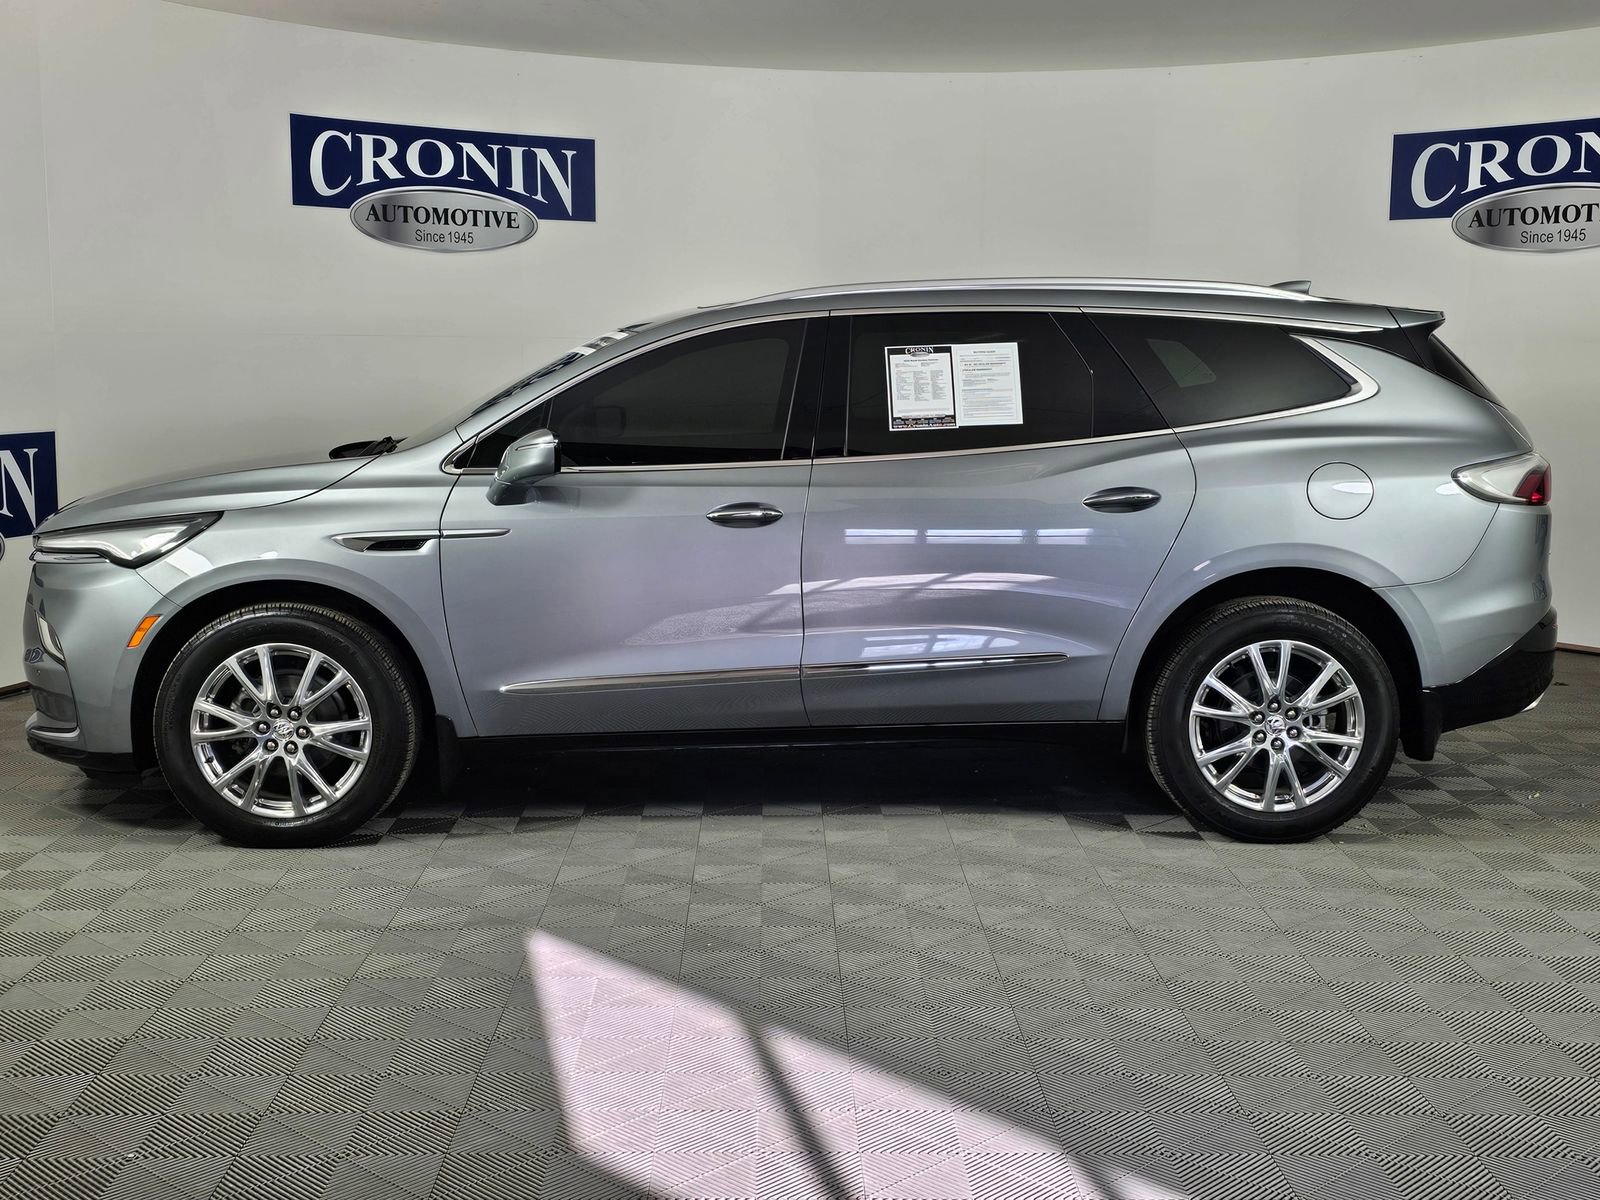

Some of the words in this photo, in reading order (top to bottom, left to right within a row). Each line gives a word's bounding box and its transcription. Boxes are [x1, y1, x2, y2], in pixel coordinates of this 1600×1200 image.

[309, 130, 577, 217] CRONIN
[365, 204, 520, 229] AUTOMOTIVE
[1468, 203, 1600, 229] AUTOMOT
[415, 229, 445, 243] Since
[448, 231, 474, 245] 1945
[1520, 230, 1554, 244] Since
[1557, 228, 1587, 243] 1945
